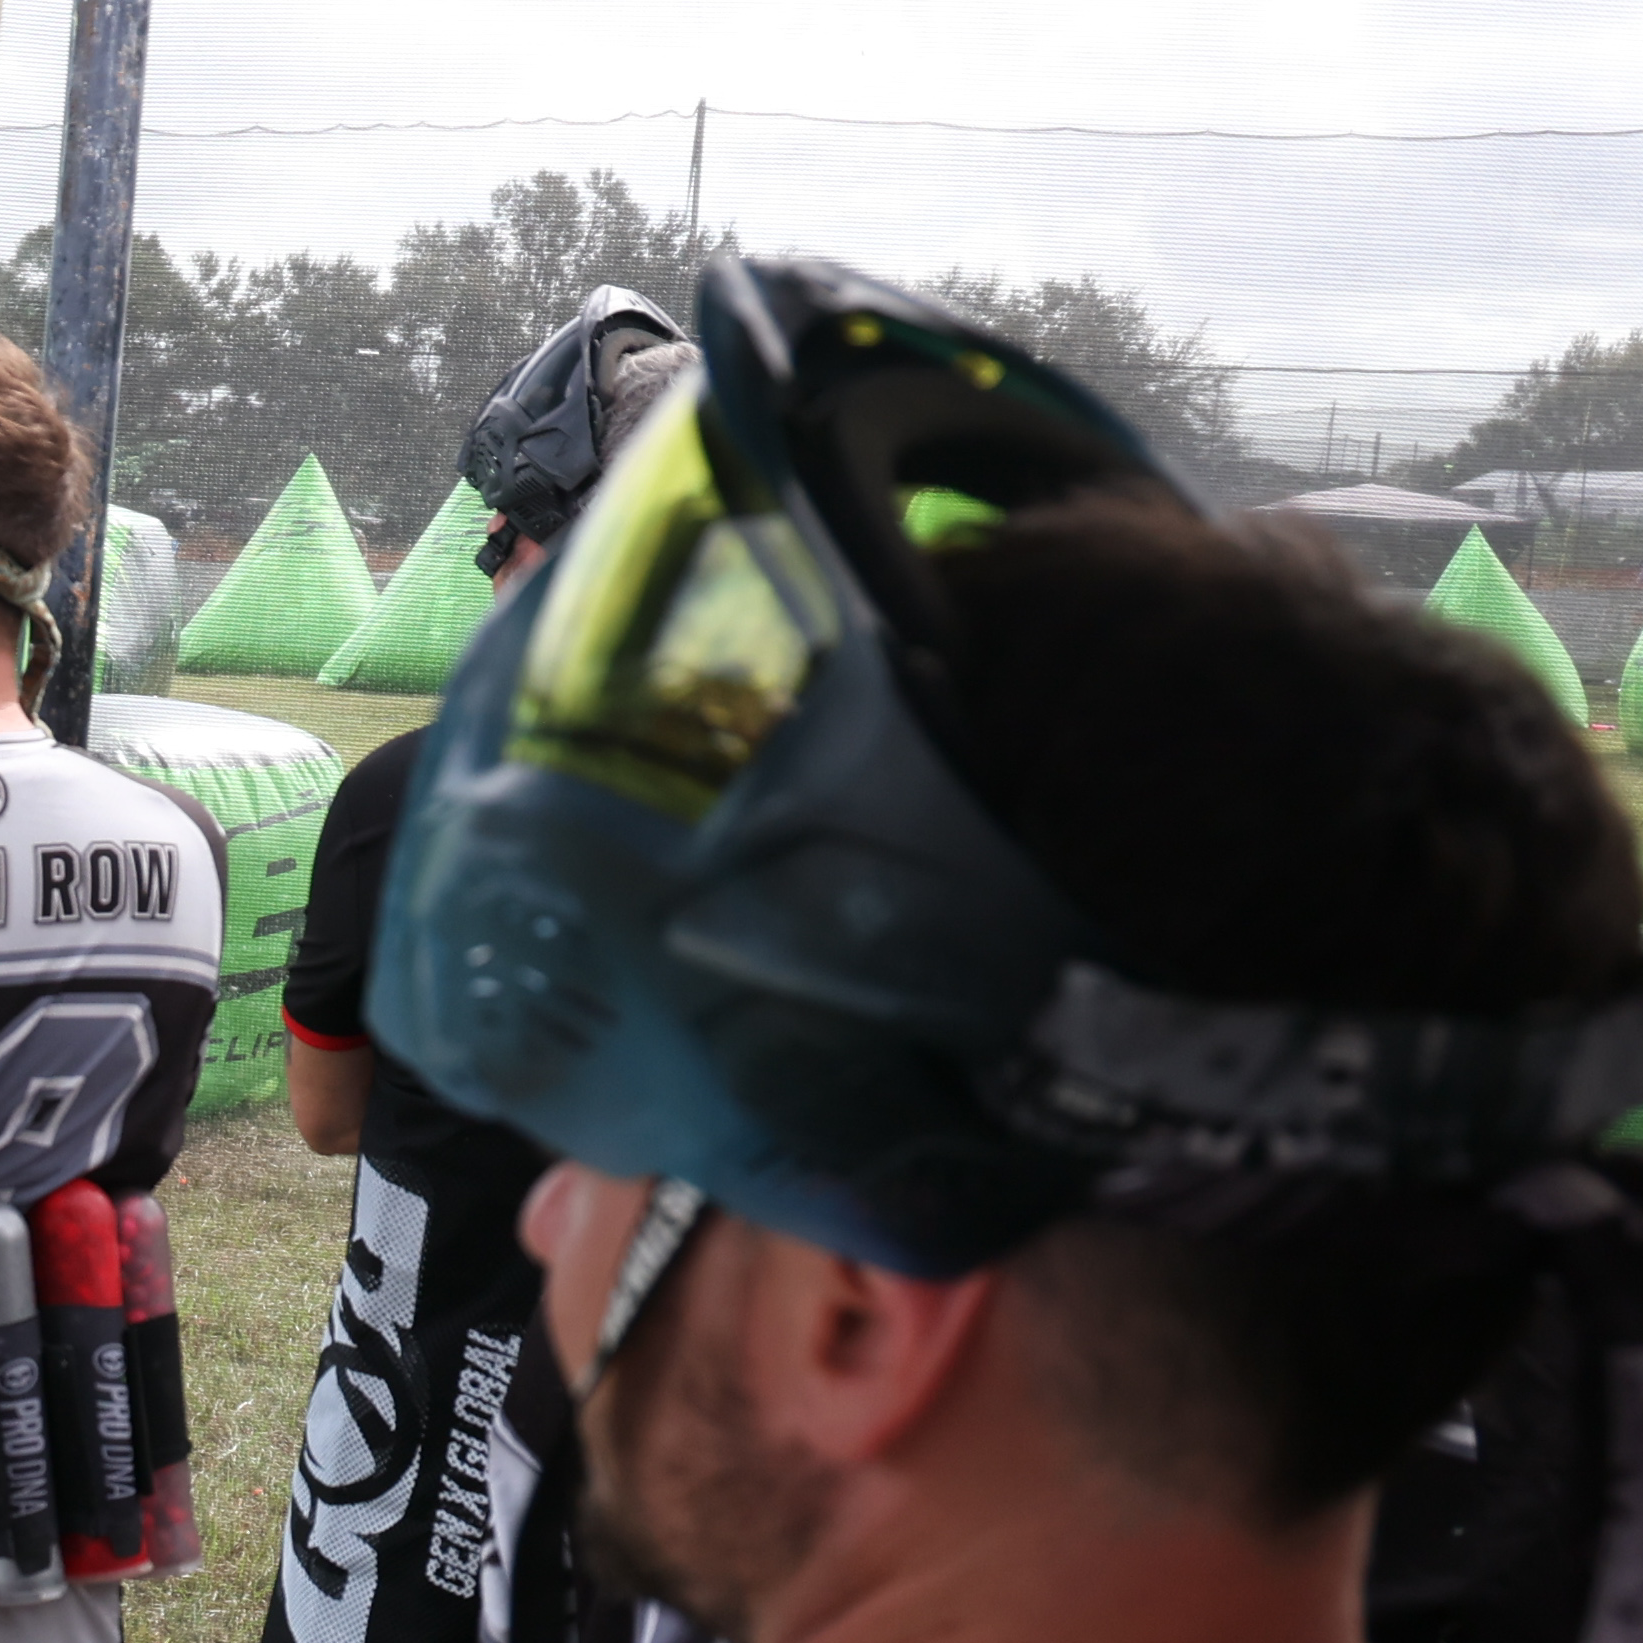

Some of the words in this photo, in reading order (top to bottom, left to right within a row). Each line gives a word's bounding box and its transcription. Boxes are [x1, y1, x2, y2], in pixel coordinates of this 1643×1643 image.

[33, 840, 180, 923] ROW
[0, 1397, 45, 1457] PRO
[94, 1382, 132, 1440] PRO
[446, 1328, 522, 1482] GLOBAL
[7, 1458, 48, 1519] DNA
[100, 1443, 137, 1500] DNA
[439, 1474, 489, 1520] X
[426, 1508, 483, 1598] GEN
